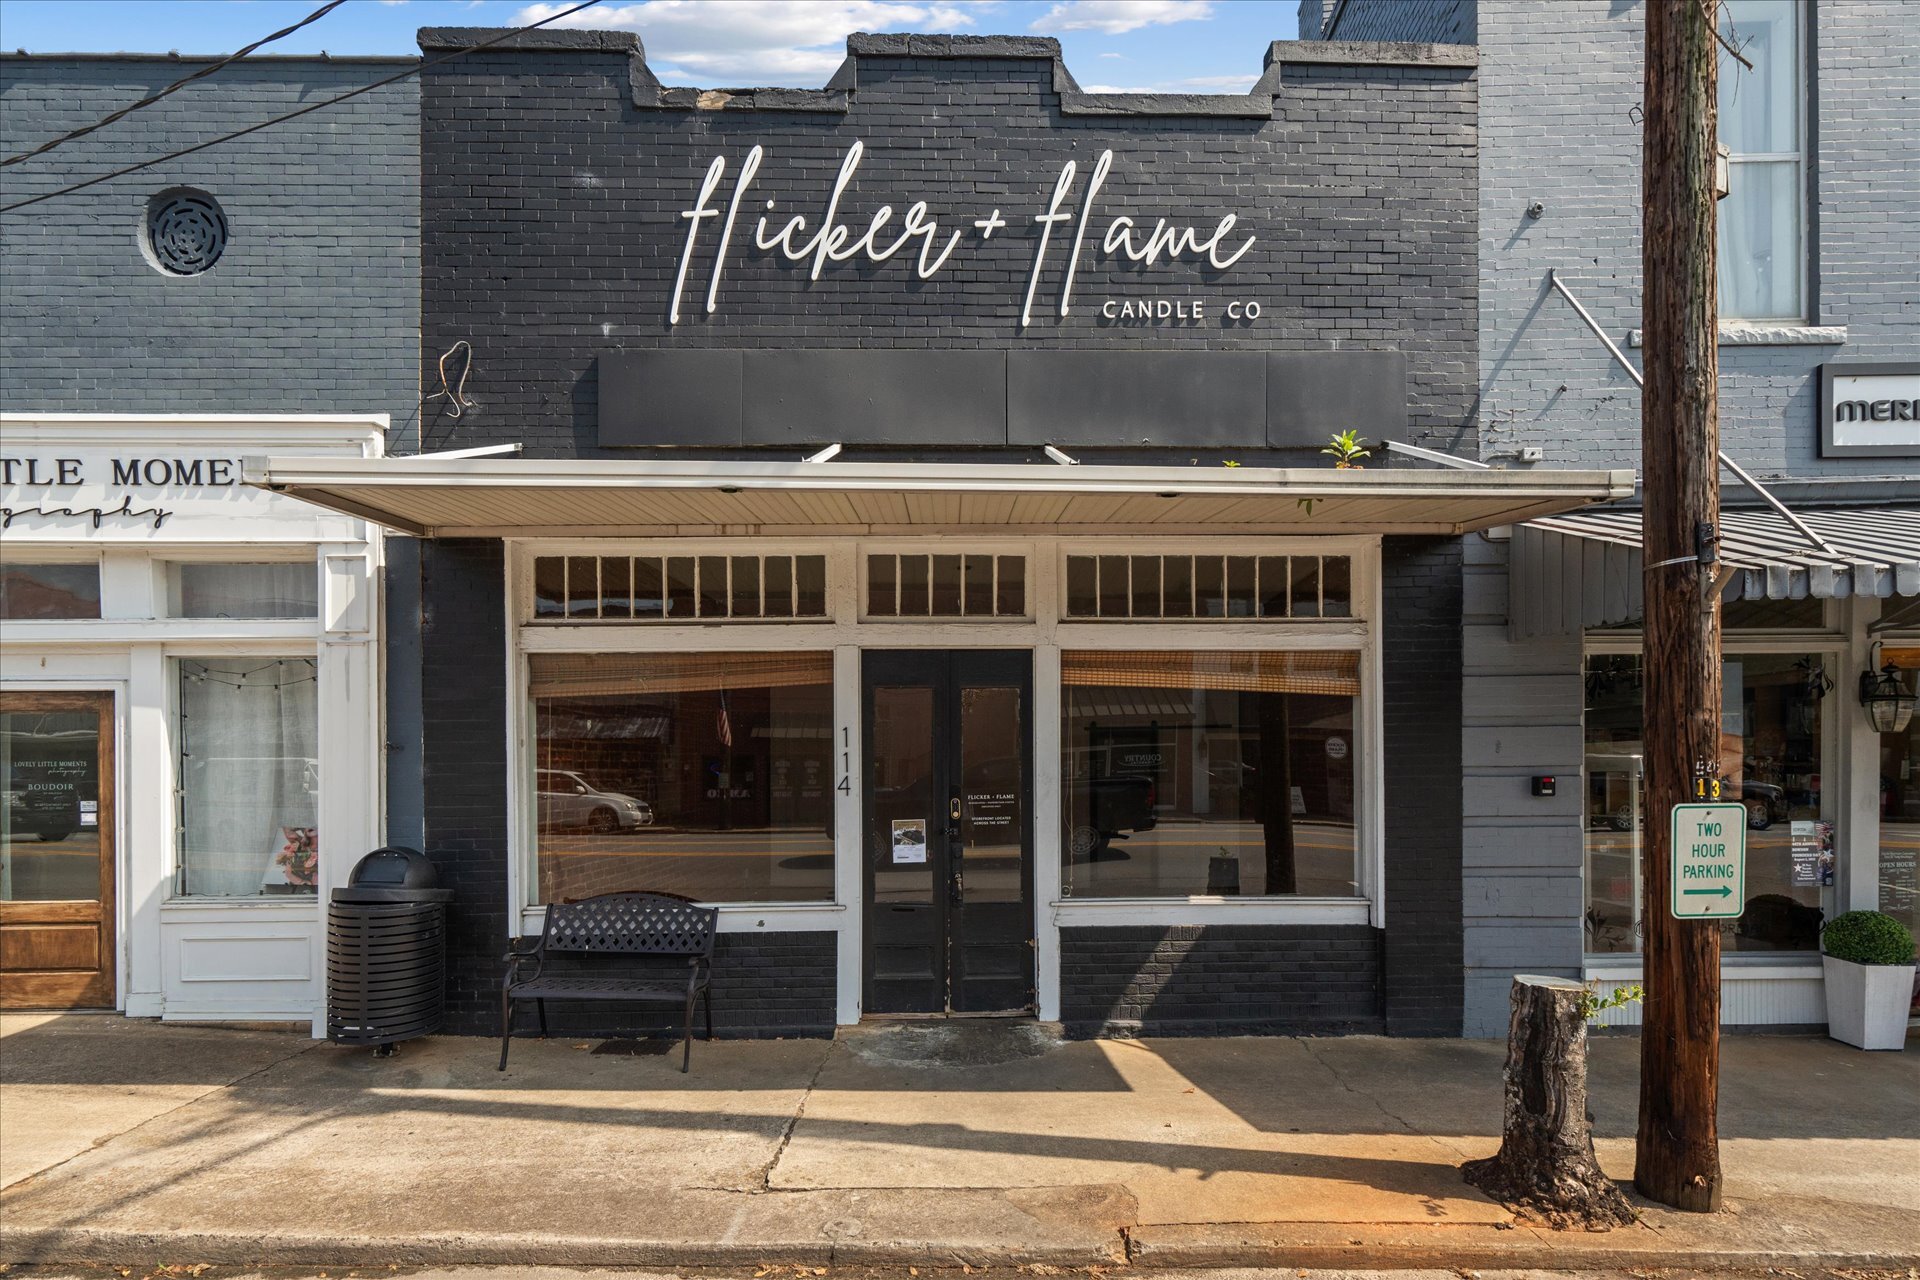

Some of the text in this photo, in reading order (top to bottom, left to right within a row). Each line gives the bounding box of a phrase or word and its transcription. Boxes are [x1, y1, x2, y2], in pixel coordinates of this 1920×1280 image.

[1102, 300, 1261, 320] CANDLE CO
[0, 458, 244, 486] TLE MOME
[837, 726, 852, 797] 114
[48, 767, 87, 777] photography
[28, 783, 74, 791] BOUDOIR
[1696, 822, 1722, 837] TWO
[1692, 843, 1726, 858] HOUR
[1683, 864, 1734, 879] PARKING
